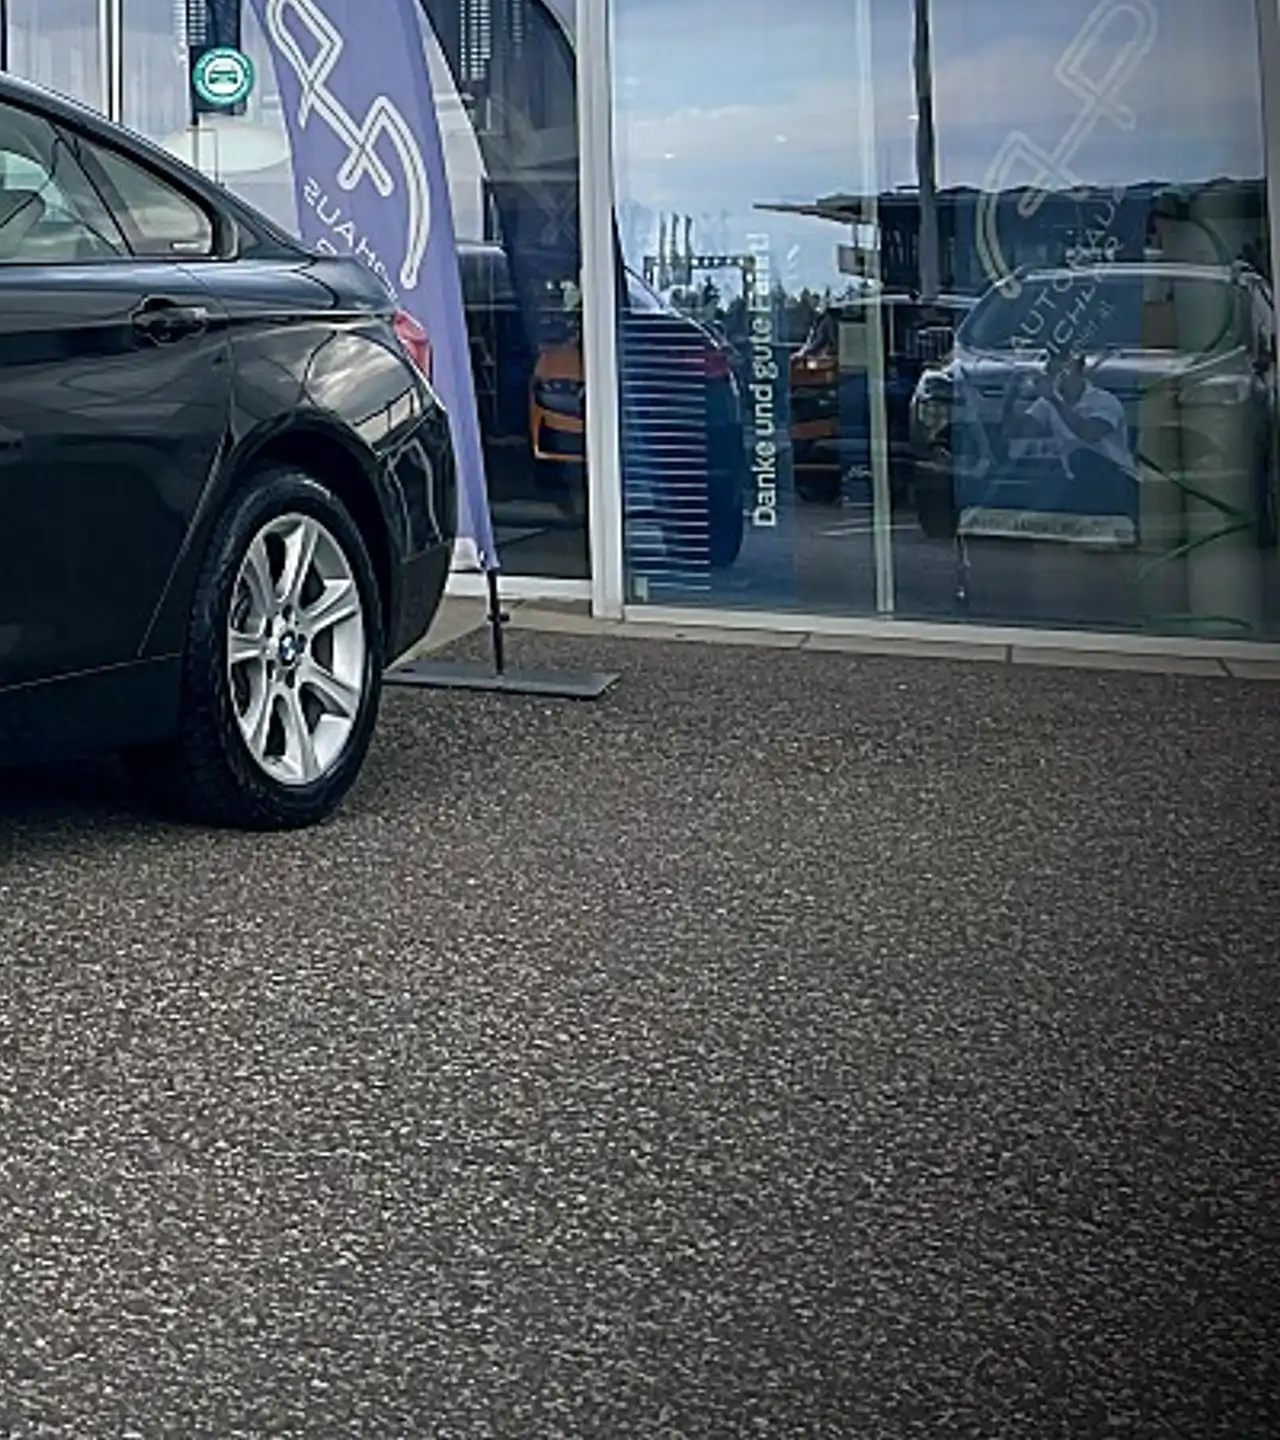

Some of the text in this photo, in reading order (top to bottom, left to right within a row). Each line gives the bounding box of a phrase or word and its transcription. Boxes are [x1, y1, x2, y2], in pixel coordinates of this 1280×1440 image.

[749, 318, 778, 379] gute
[749, 384, 776, 437] und
[751, 446, 777, 527] Danke
